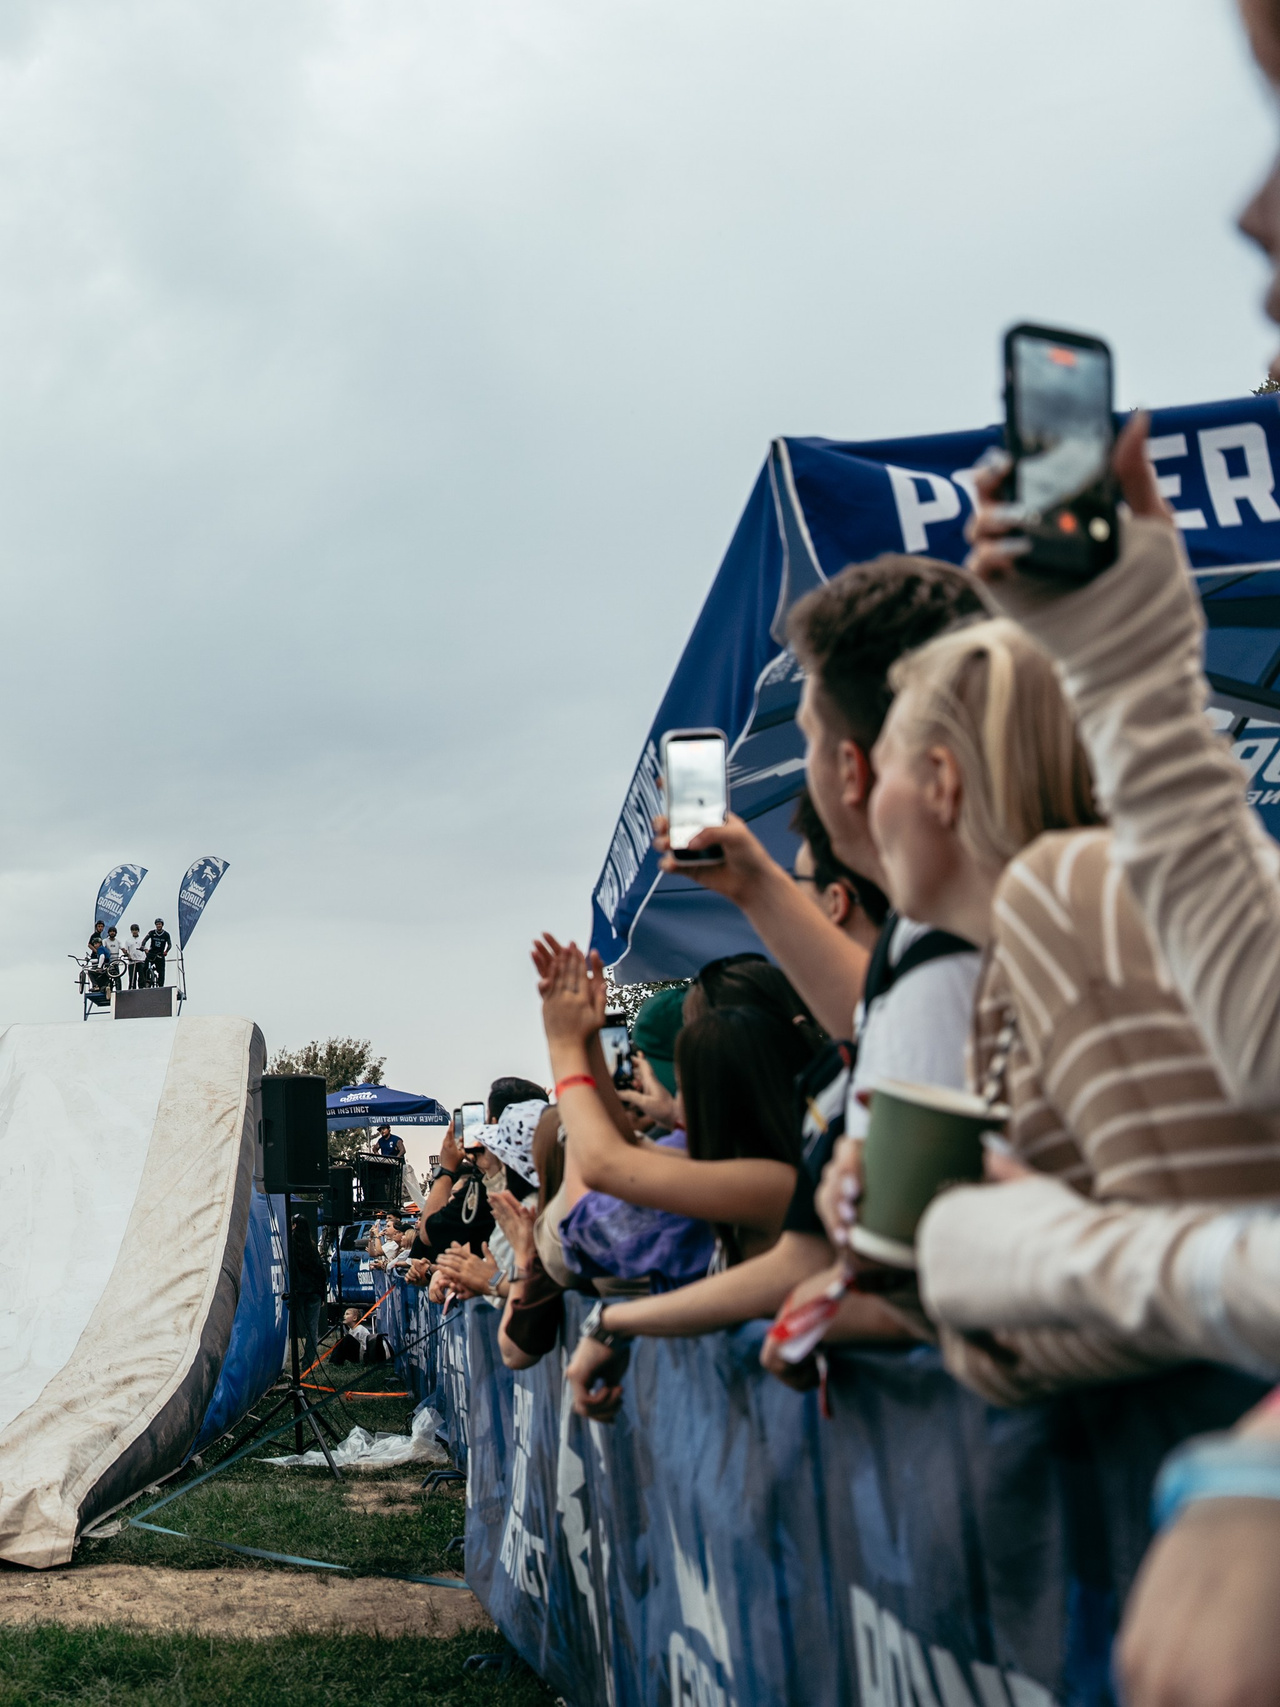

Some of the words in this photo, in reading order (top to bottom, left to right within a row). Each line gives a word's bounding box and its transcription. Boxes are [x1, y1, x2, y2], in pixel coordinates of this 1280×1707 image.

[885, 421, 1280, 554] PER
[97, 896, 124, 915] GORILLA
[179, 889, 205, 910] GORILLA
[338, 1105, 370, 1115] INSTINCT
